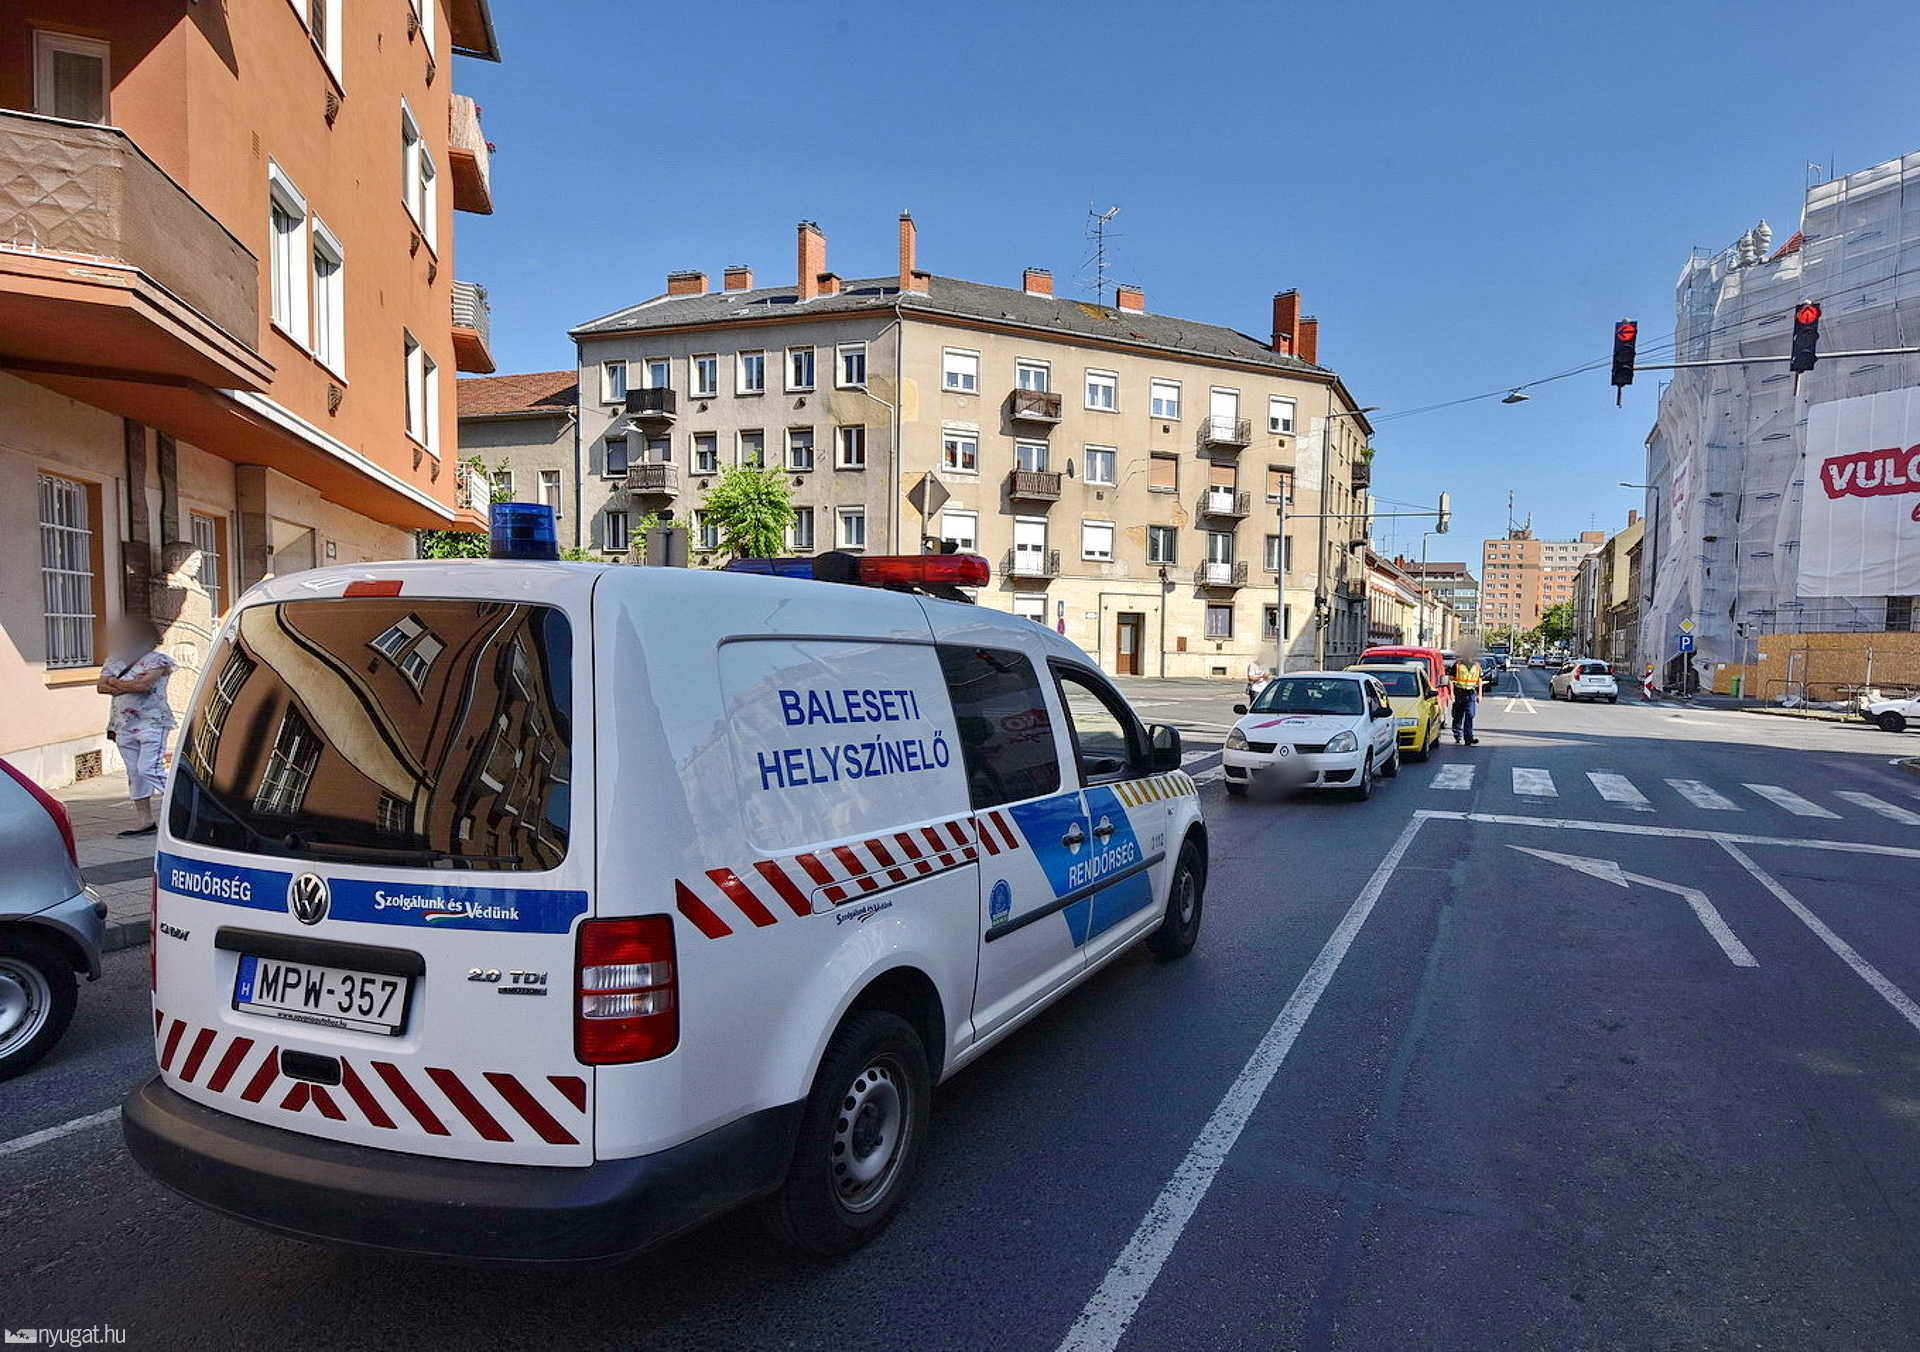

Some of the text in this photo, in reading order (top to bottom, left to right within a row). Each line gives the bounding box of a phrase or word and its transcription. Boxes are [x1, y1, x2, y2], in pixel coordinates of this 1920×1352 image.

[1682, 637, 1690, 650] P
[778, 689, 920, 726] BALESETI
[757, 730, 949, 790] HELYSZÍNELŐ
[1068, 840, 1135, 889] RENDŐRSÉG
[170, 868, 251, 901] RENDŐRSÉG
[374, 890, 519, 921] Szolgálunk és Védünk
[241, 983, 250, 996] H
[258, 963, 399, 1019] MPW-357
